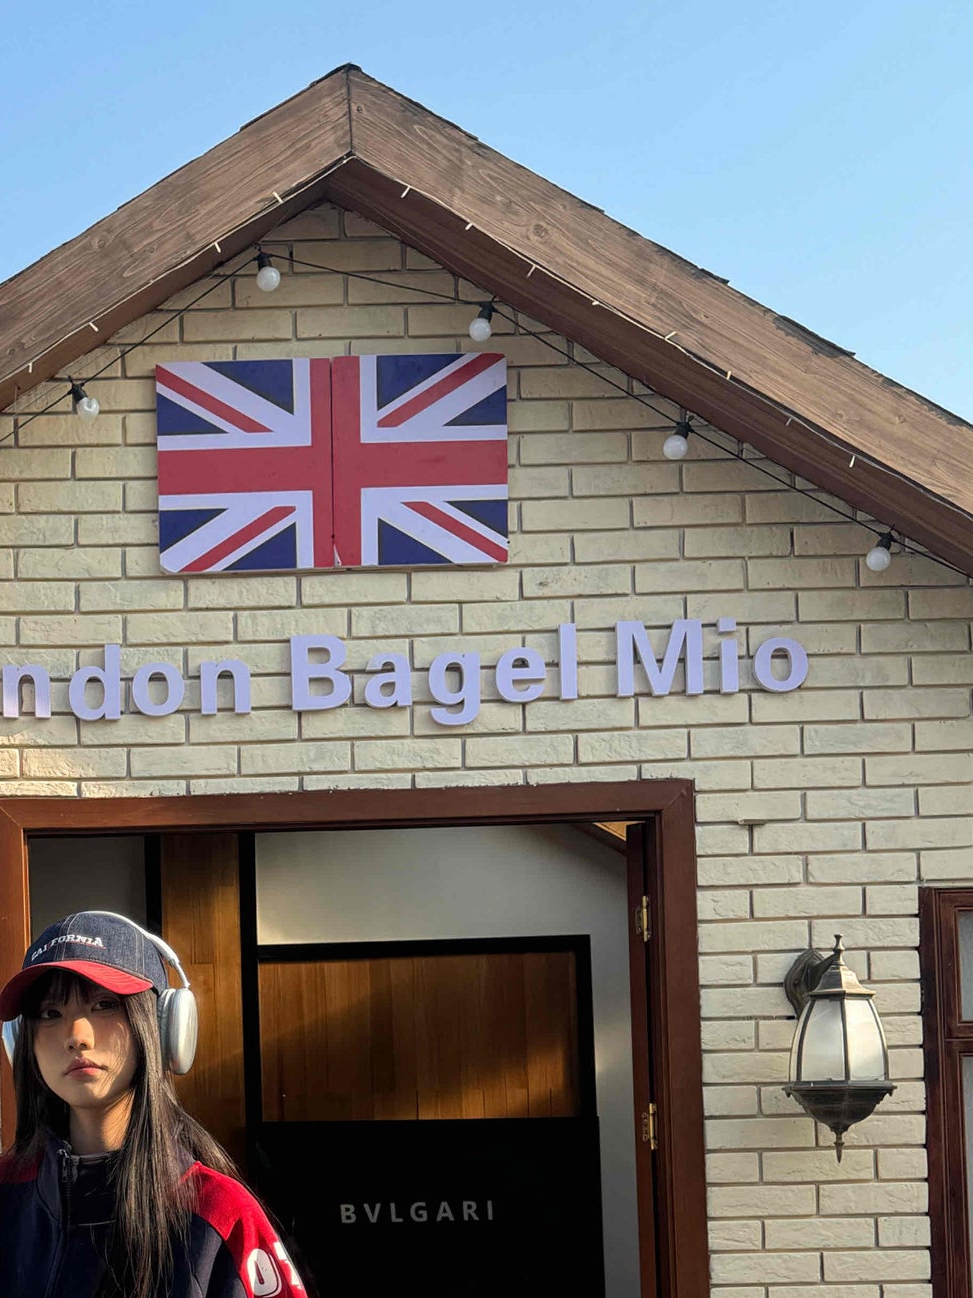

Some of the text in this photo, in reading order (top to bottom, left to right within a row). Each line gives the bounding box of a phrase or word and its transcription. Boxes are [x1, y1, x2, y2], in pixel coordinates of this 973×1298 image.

[290, 622, 578, 727] Bagel
[615, 618, 809, 698] Mio
[340, 1200, 494, 1224] BVLGARI
